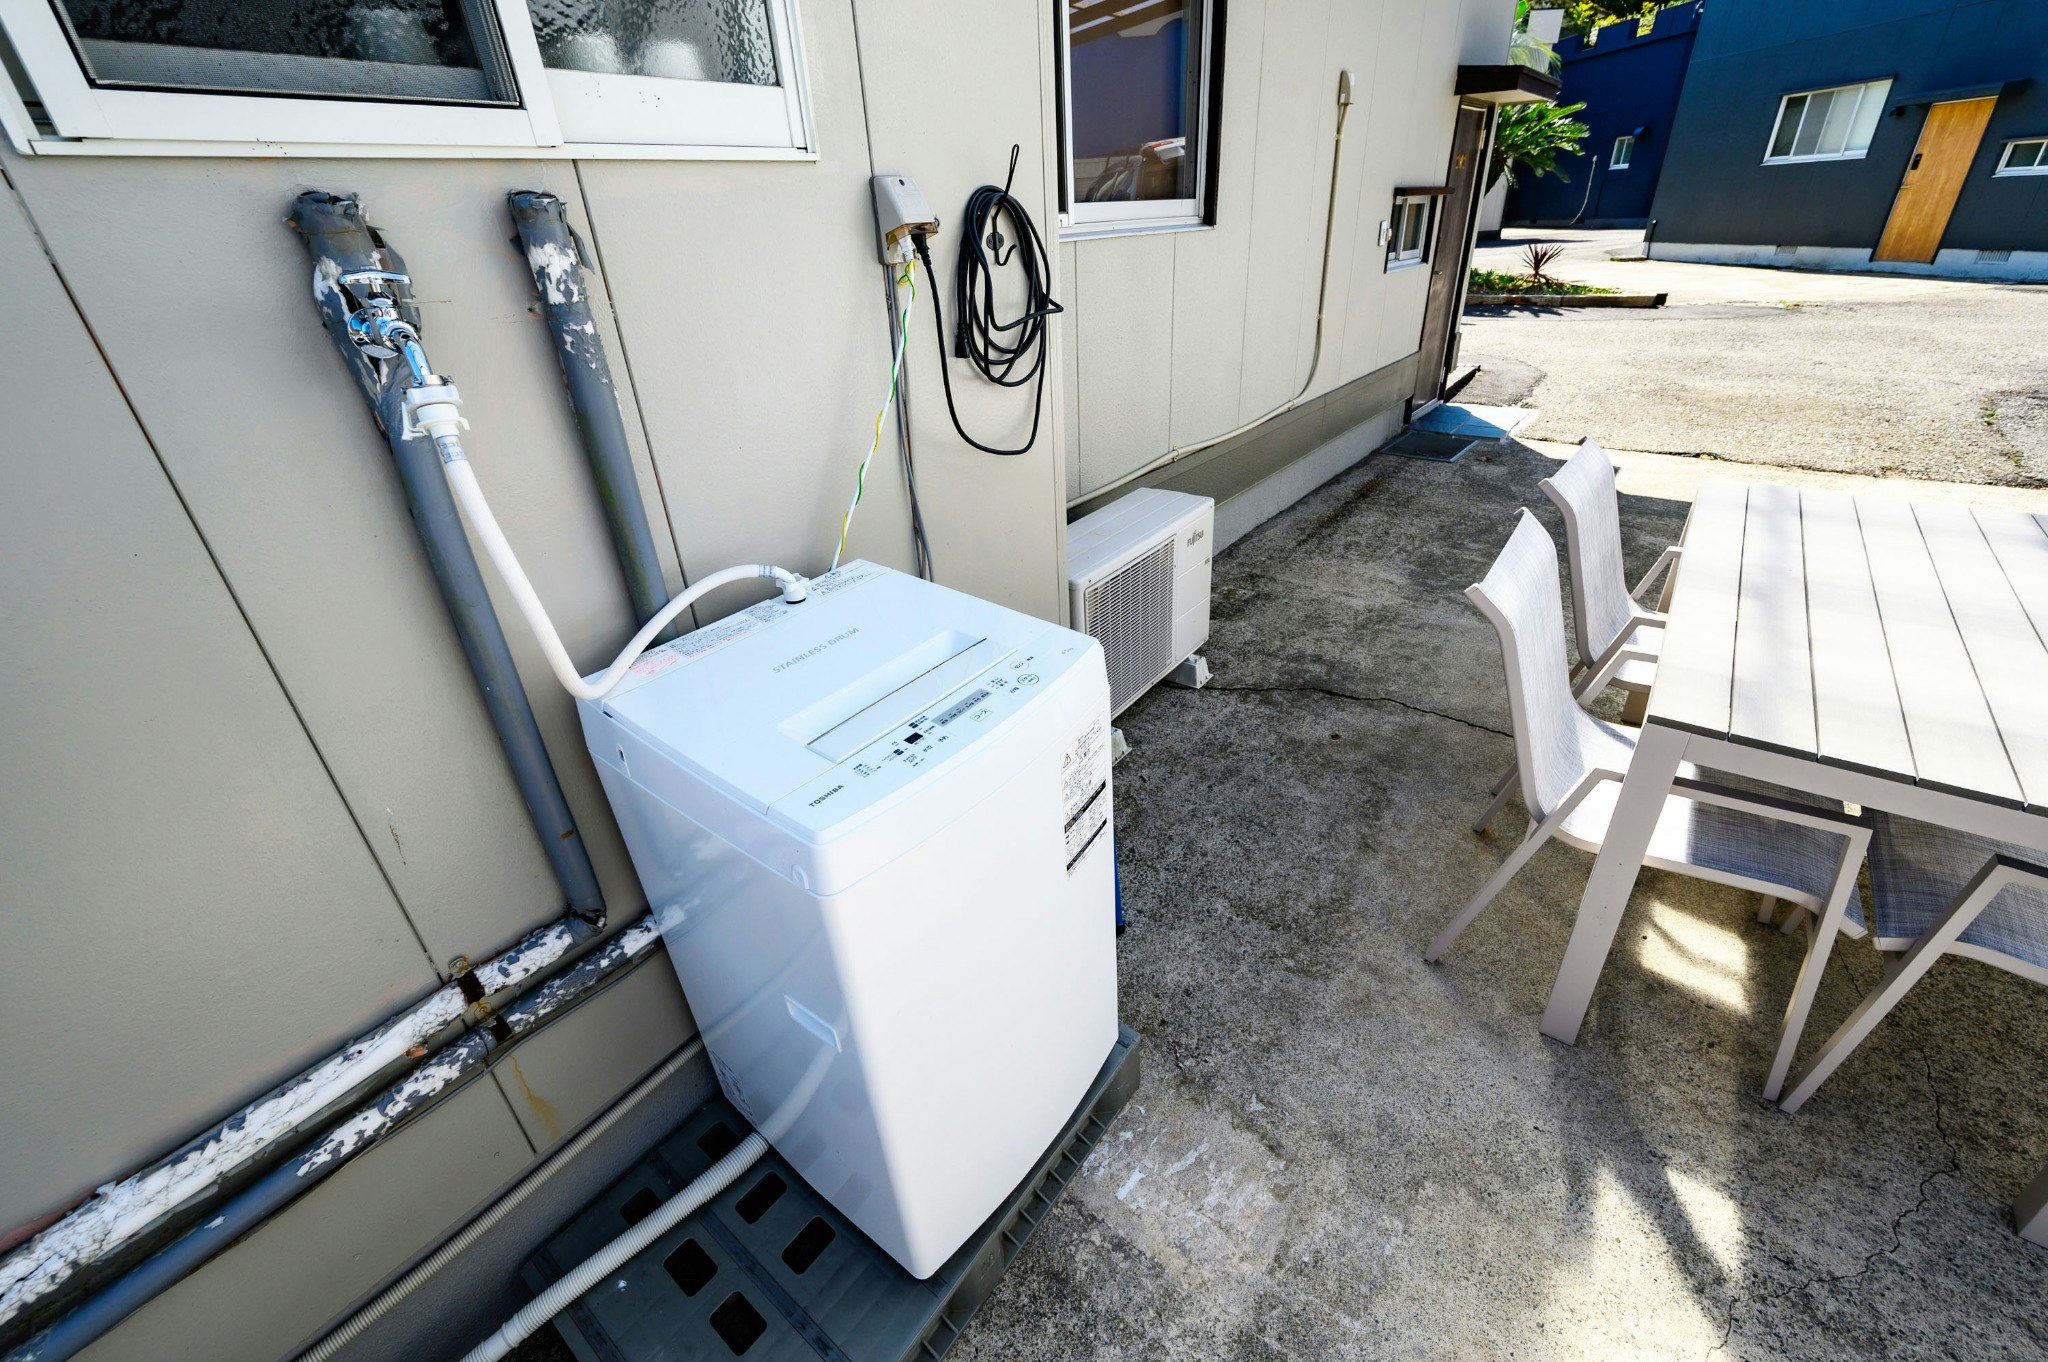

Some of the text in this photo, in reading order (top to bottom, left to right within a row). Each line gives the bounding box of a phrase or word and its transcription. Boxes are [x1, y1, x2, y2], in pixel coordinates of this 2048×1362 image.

[772, 627, 860, 674] STAINLESS DRUM
[808, 784, 845, 807] TOSHIBA
